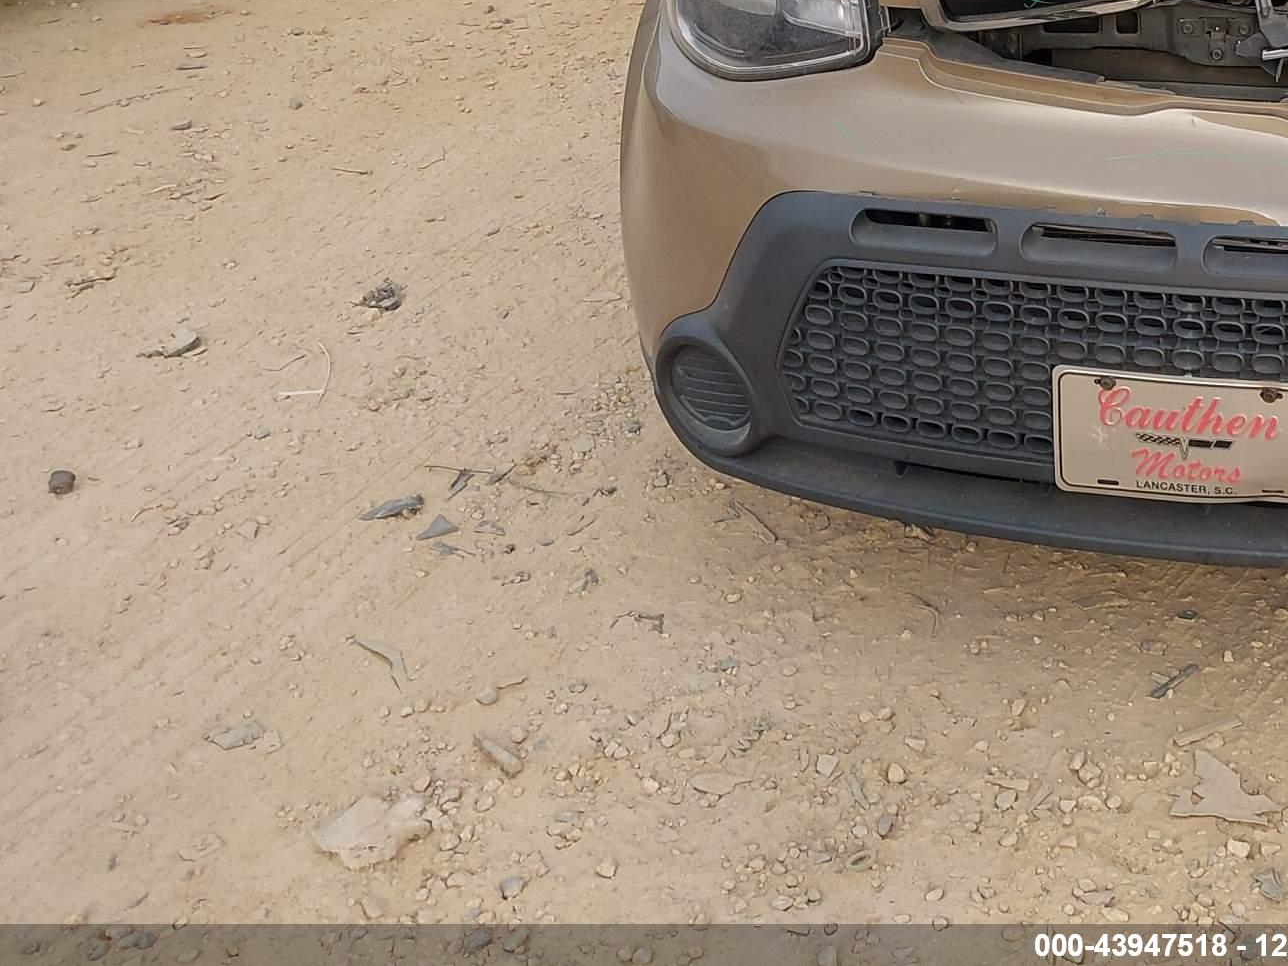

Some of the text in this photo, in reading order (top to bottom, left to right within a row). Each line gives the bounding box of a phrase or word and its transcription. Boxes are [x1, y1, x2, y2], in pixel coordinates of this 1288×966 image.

[1097, 385, 1280, 441] Cauthen
[1130, 447, 1243, 484] Motors
[1136, 479, 1238, 495] LANCASTER, S.C.
